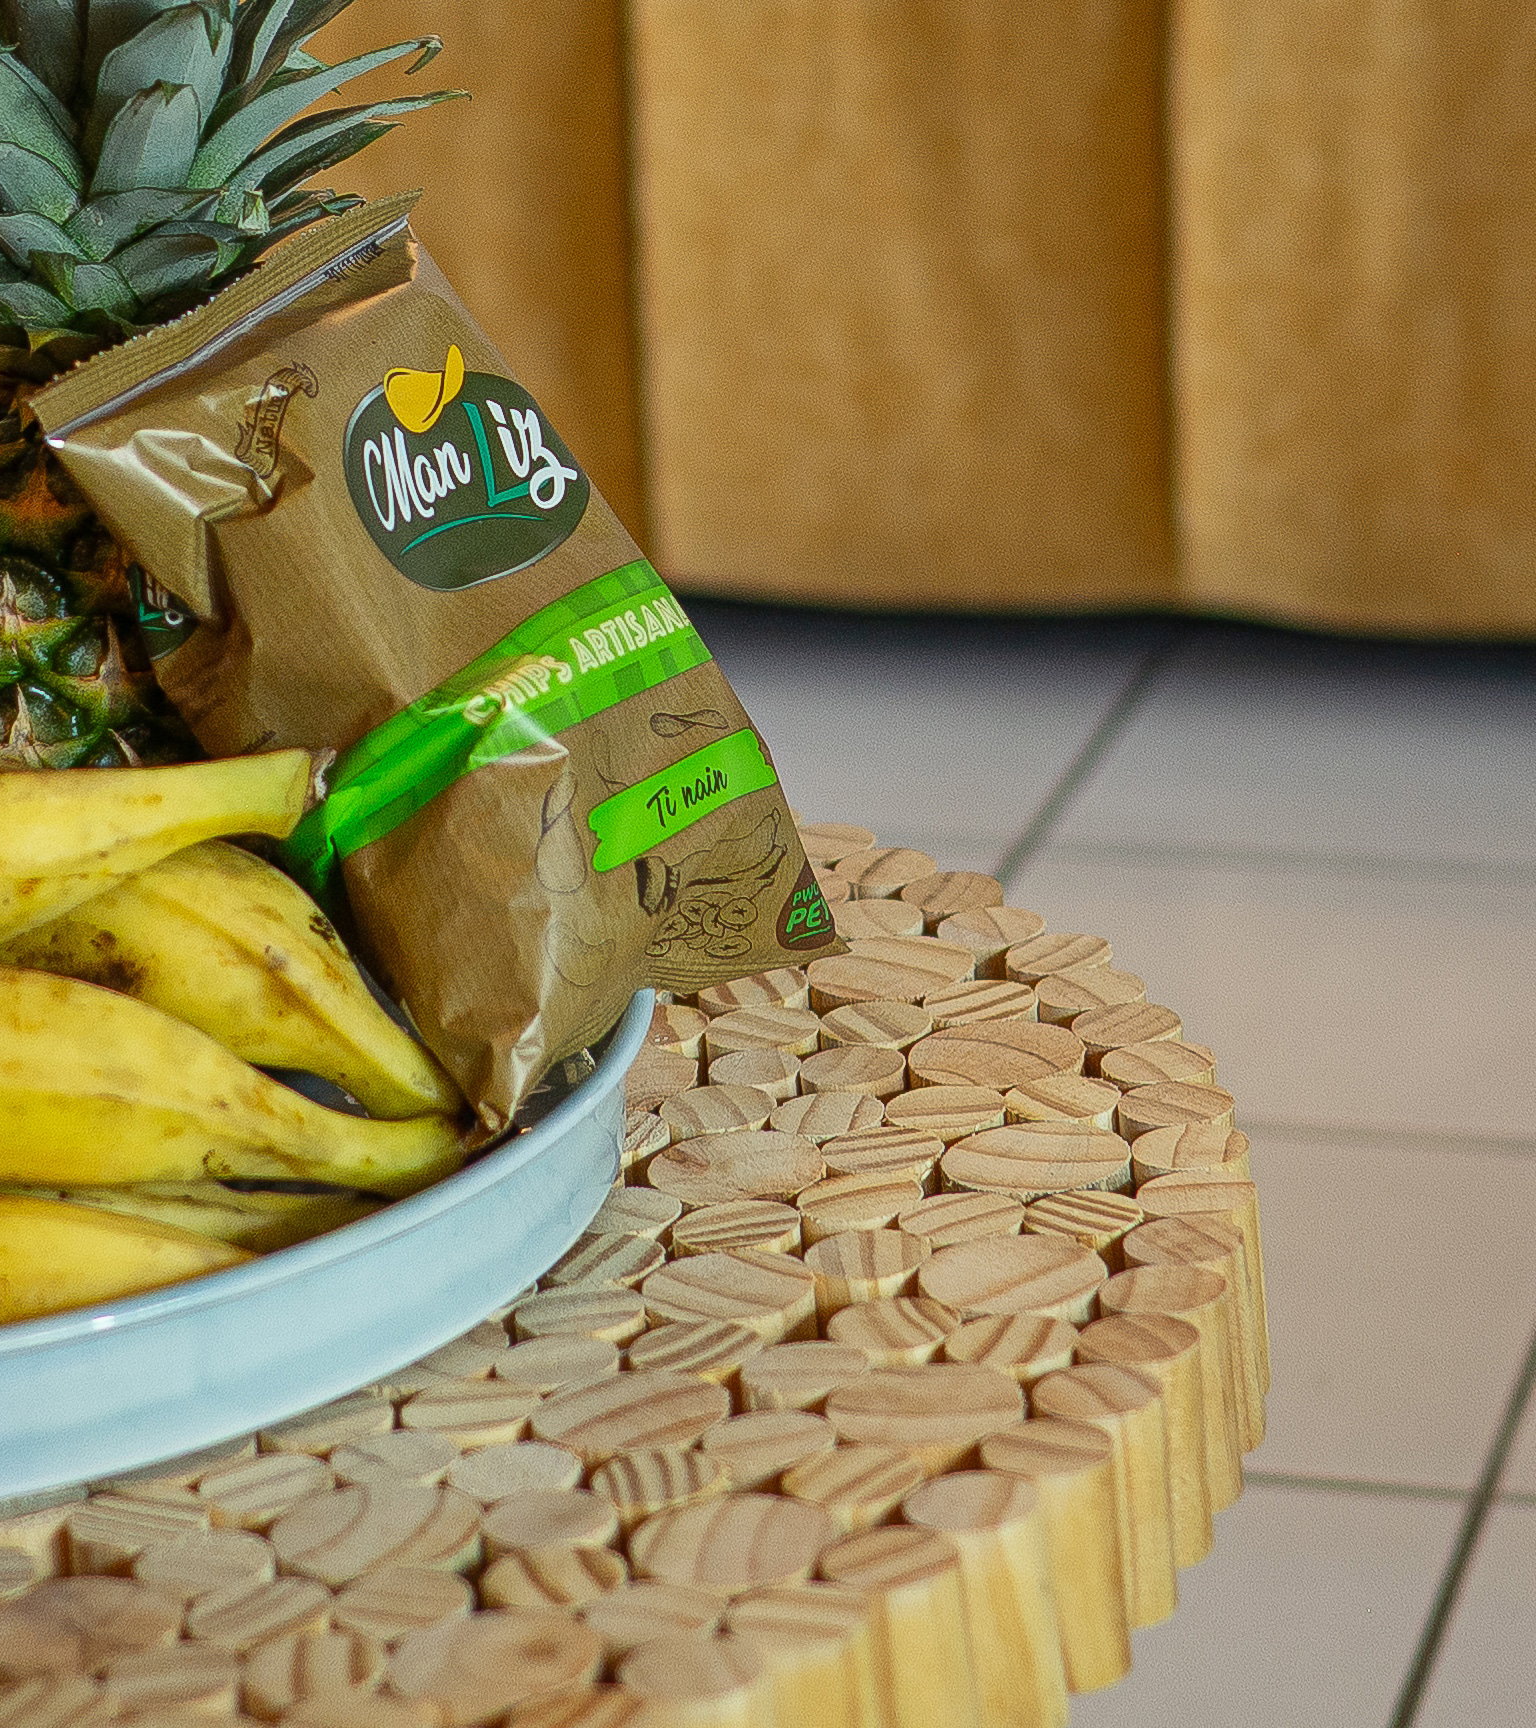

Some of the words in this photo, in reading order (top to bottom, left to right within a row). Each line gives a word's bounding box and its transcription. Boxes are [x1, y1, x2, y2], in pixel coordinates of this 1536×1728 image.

[363, 427, 471, 532] Man
[462, 399, 578, 510] Liz
[646, 785, 677, 828] Ti
[681, 766, 728, 809] nain
